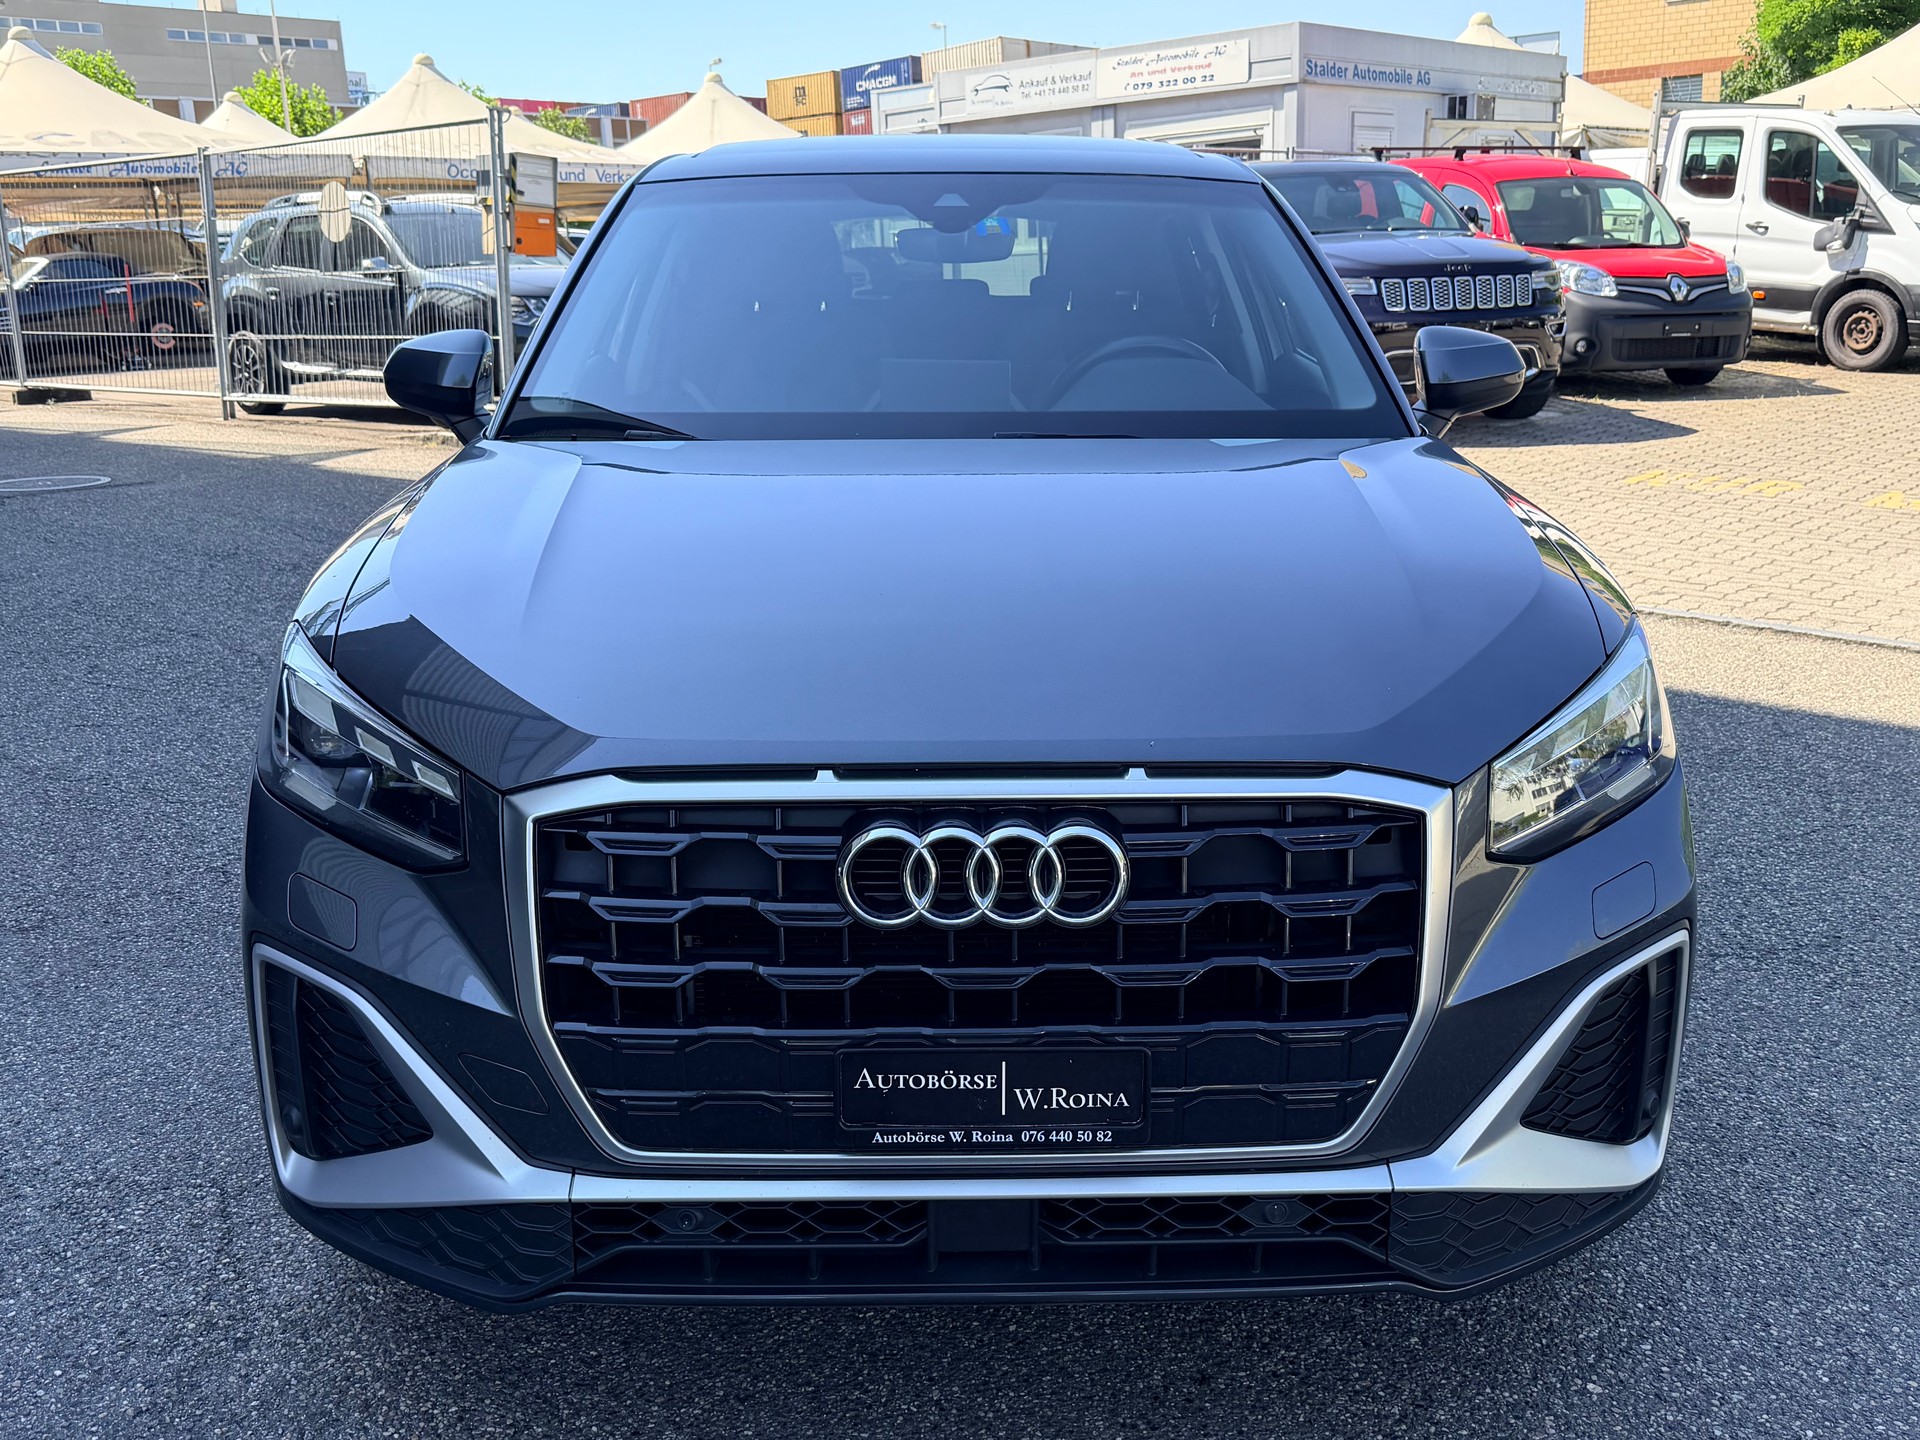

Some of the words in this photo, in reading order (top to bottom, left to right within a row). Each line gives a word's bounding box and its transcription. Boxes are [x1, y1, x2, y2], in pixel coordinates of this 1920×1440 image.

[1147, 68, 1166, 76] und
[1170, 63, 1212, 73] Verkauf
[1306, 59, 1348, 79] Stalder
[1352, 64, 1413, 85] Automobile
[1416, 70, 1431, 86] AG
[1019, 76, 1048, 89] Ankauf
[1059, 70, 1092, 84] Verkauf
[1132, 82, 1153, 91] 079
[1158, 79, 1178, 88] 322
[1182, 76, 1196, 84] 00
[1200, 74, 1215, 82] 22
[215, 162, 248, 177] AG
[447, 163, 479, 179] Occ
[559, 168, 585, 181] und
[595, 168, 634, 184] Verka
[871, 1131, 945, 1144] Autobörse
[949, 1131, 967, 1144] W.
[971, 1131, 1014, 1144] Roina
[1021, 1130, 1045, 1143] 076
[1049, 1130, 1073, 1143] 440
[1076, 1130, 1093, 1143] 50
[1096, 1130, 1113, 1143] 82
